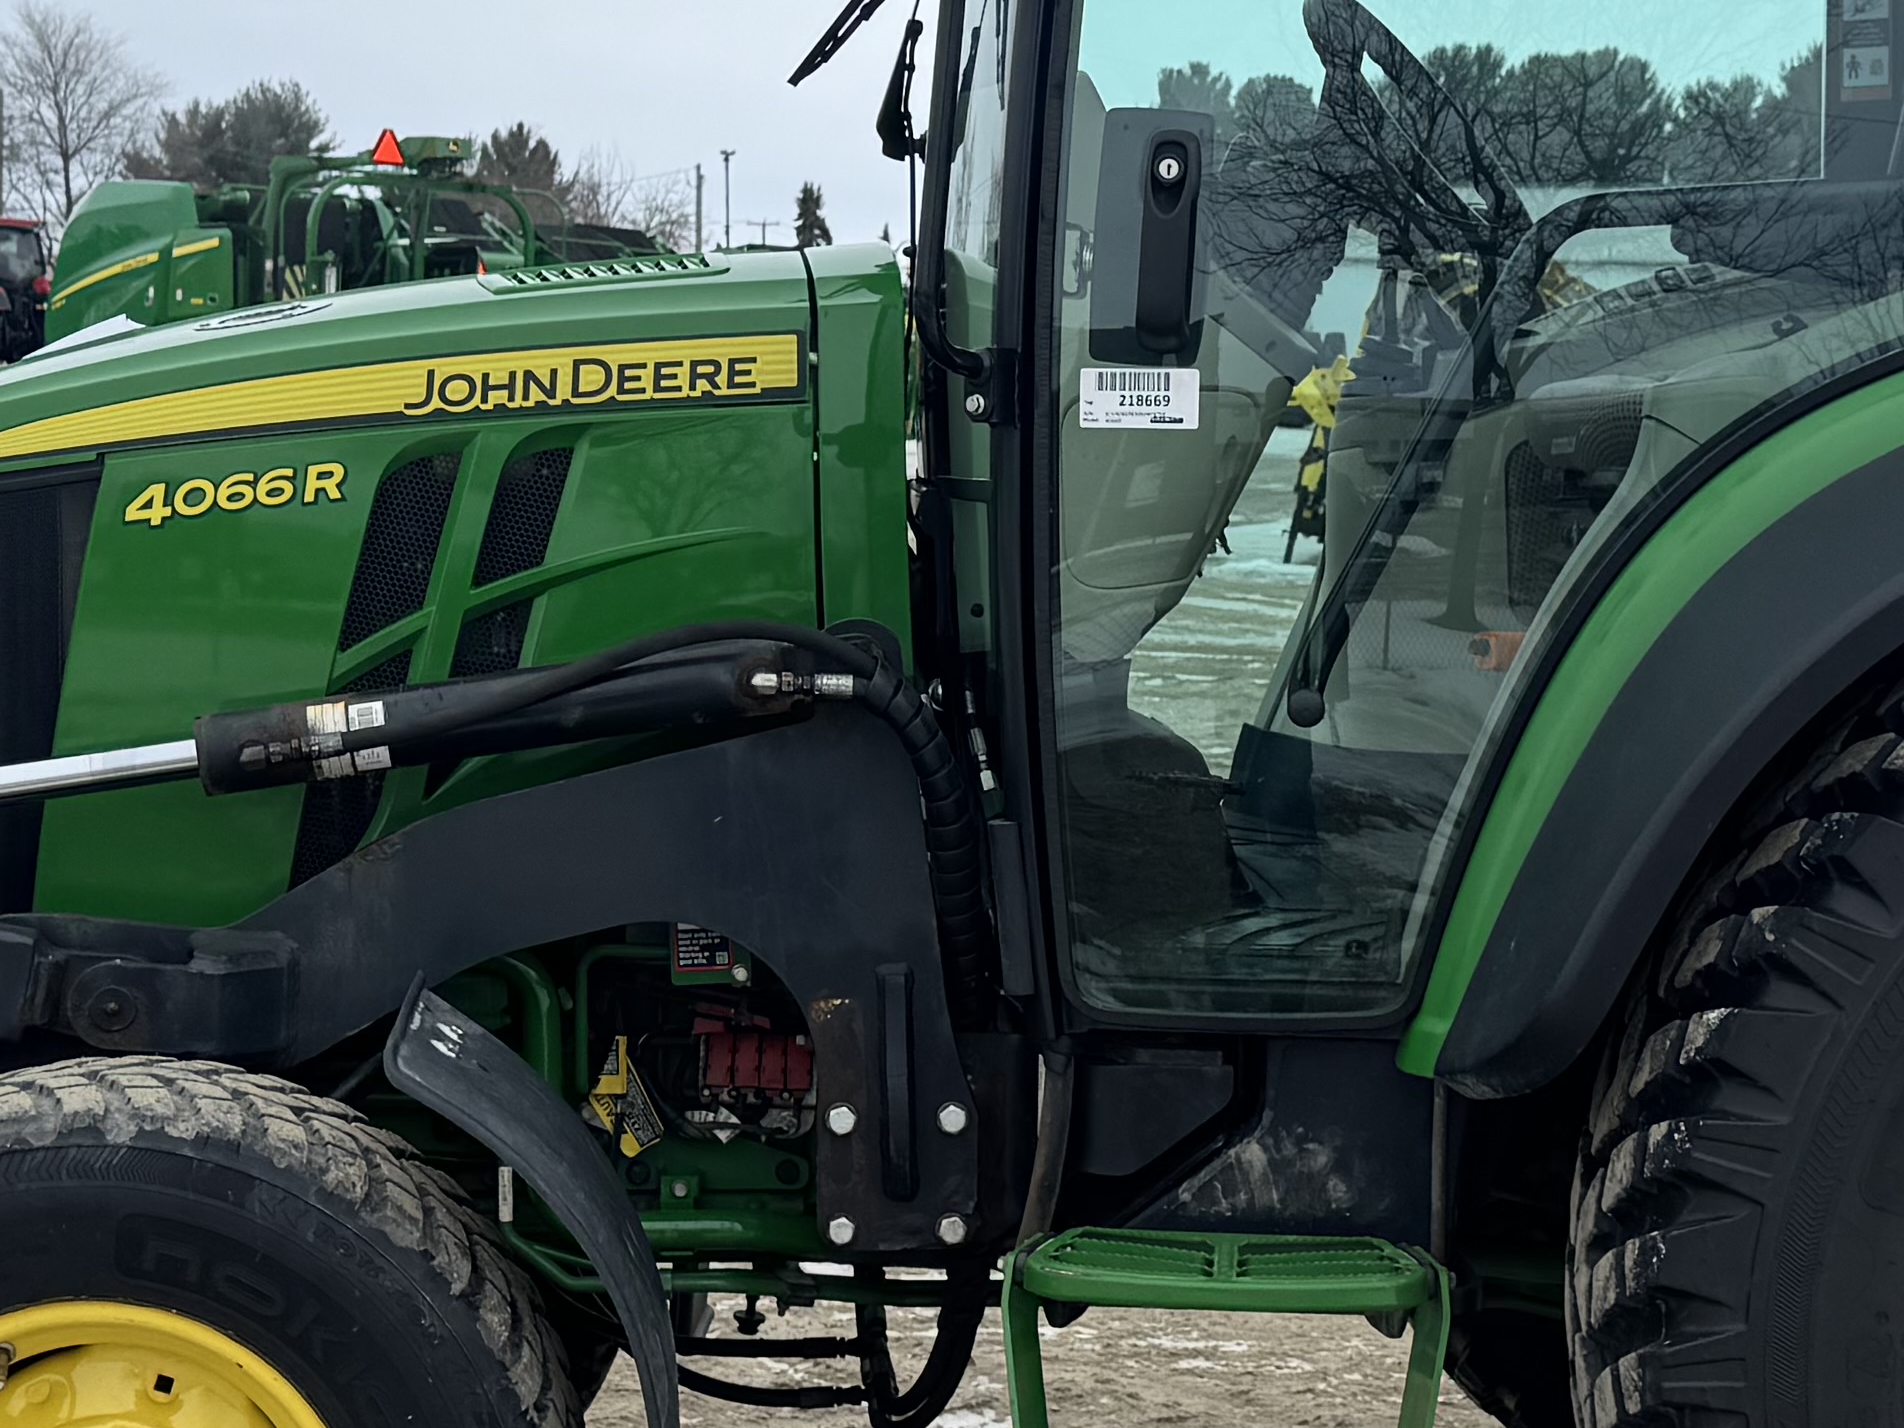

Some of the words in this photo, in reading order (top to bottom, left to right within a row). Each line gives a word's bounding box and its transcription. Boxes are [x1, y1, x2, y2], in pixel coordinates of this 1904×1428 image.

[404, 367, 559, 411] JOHN
[571, 356, 758, 400] DEERE
[1118, 394, 1171, 407] 218669
